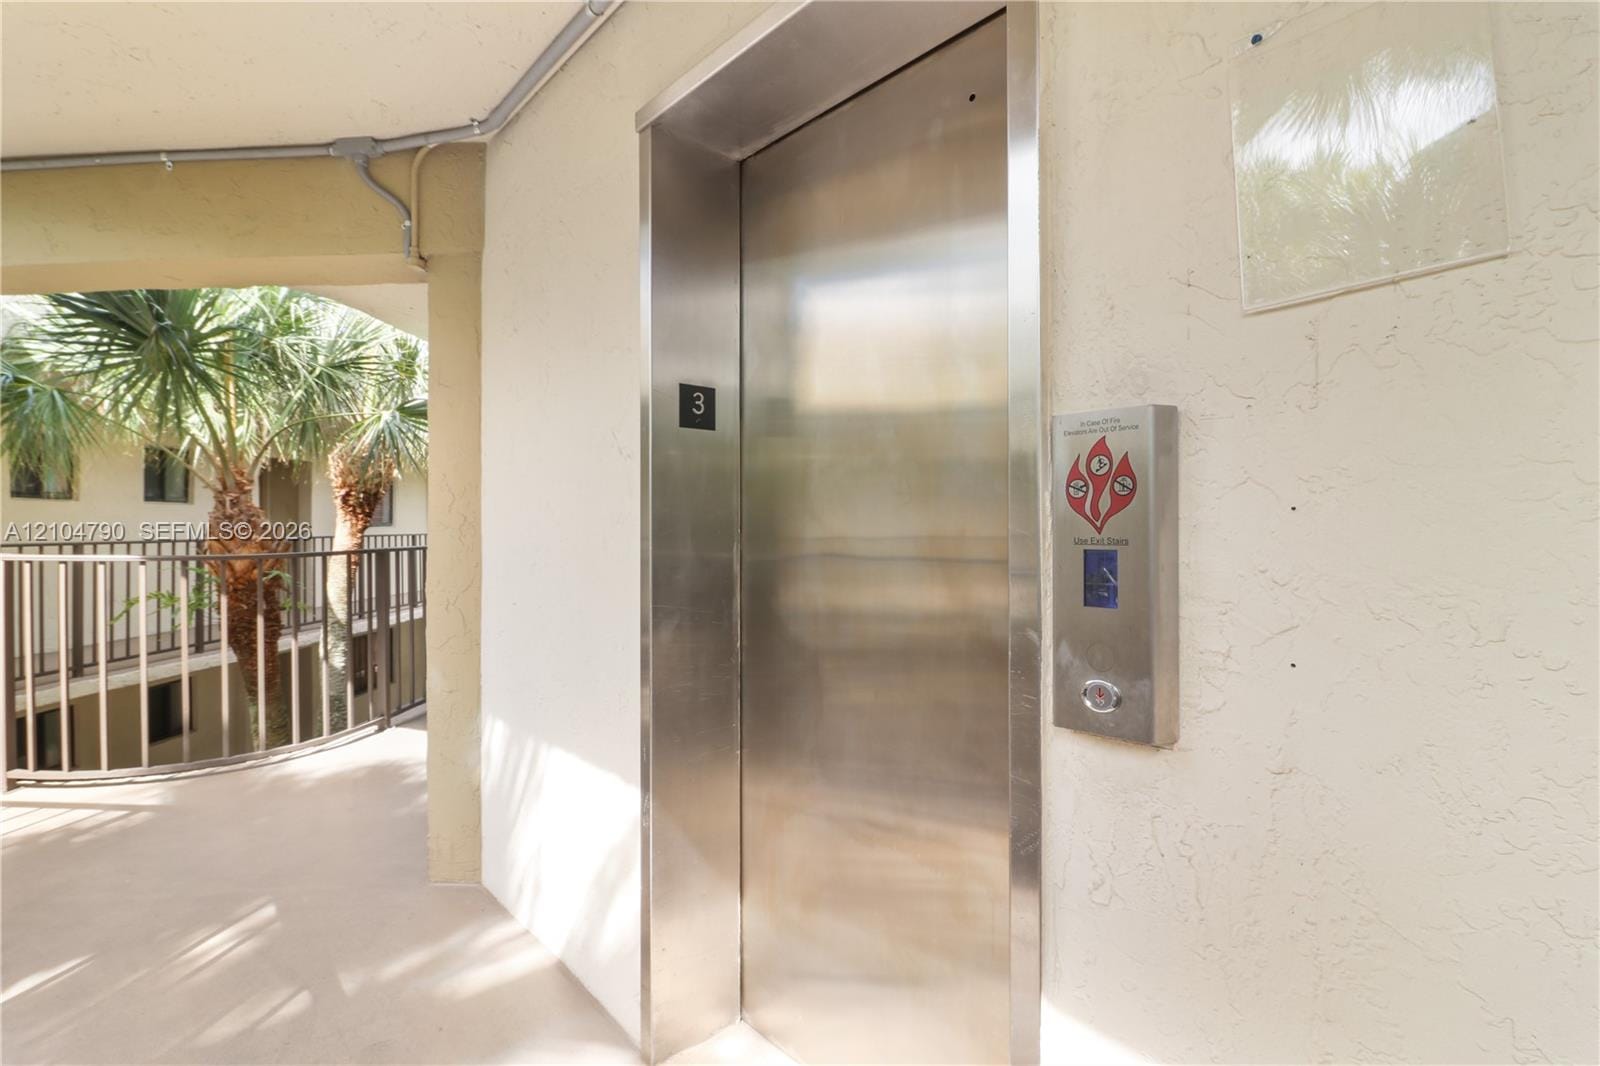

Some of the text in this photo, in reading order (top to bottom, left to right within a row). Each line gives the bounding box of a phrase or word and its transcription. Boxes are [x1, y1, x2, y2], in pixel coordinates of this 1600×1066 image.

[692, 392, 705, 415] 3
[1118, 424, 1139, 432] Service
[1073, 536, 1129, 545] Use Exit Stairs
